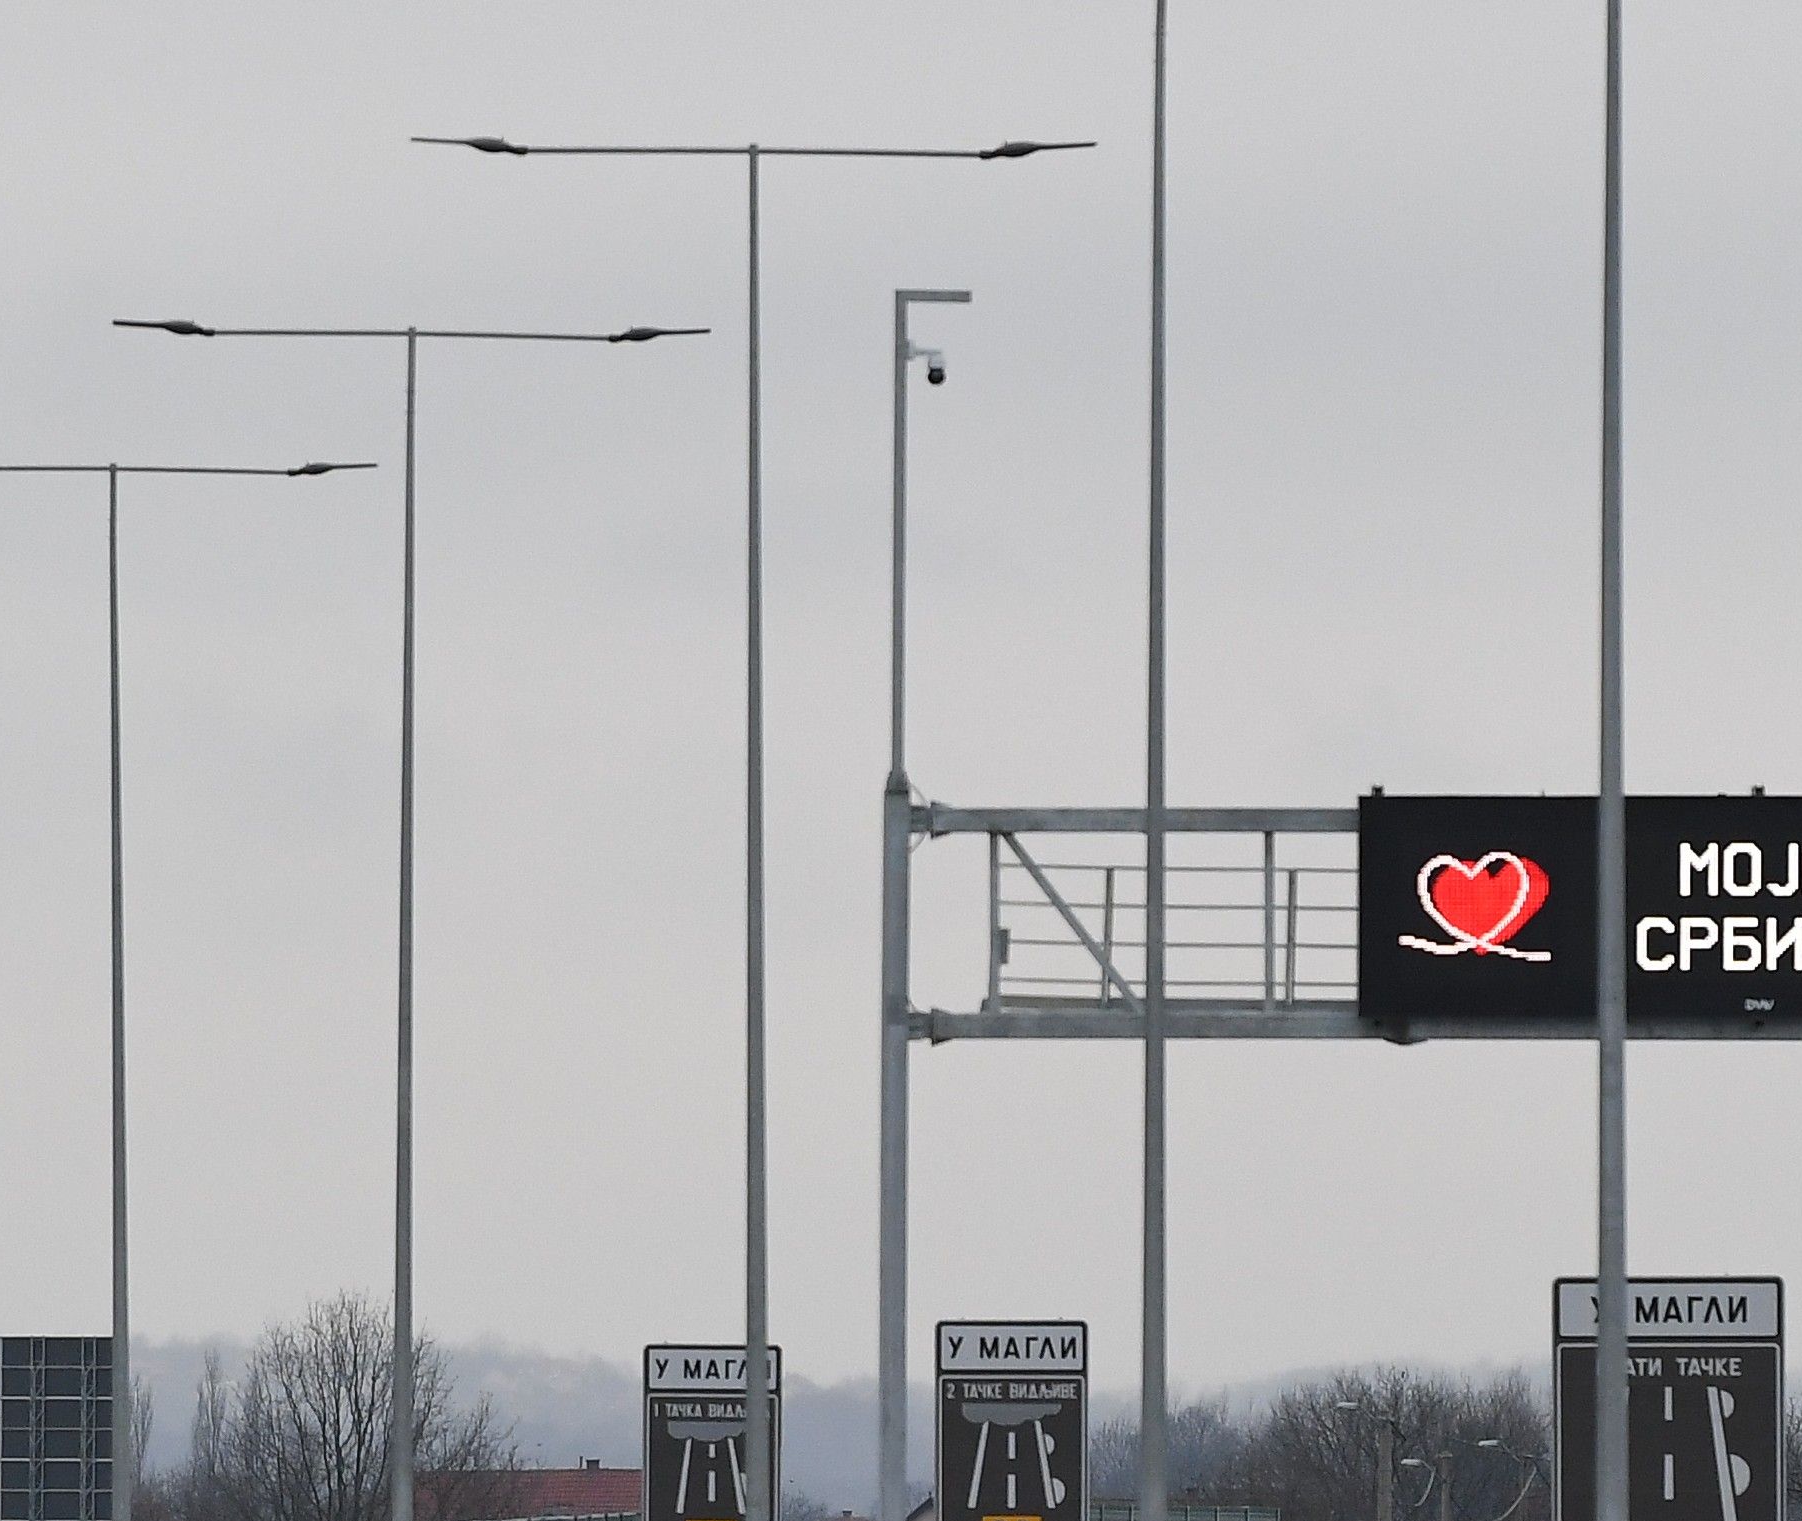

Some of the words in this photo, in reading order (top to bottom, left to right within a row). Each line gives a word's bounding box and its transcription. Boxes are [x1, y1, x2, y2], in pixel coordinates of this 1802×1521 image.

[1635, 1296, 1747, 1323] МАГЛИ
[949, 1336, 963, 1359] У
[979, 1336, 1078, 1359] МАГЛИ
[655, 1359, 669, 1379] У
[1676, 1357, 1743, 1377] ТАЧКЕ
[945, 1382, 956, 1400] 2
[962, 1382, 1003, 1399] ТАЧКЕ
[665, 1403, 703, 1418] ТАЧКА
